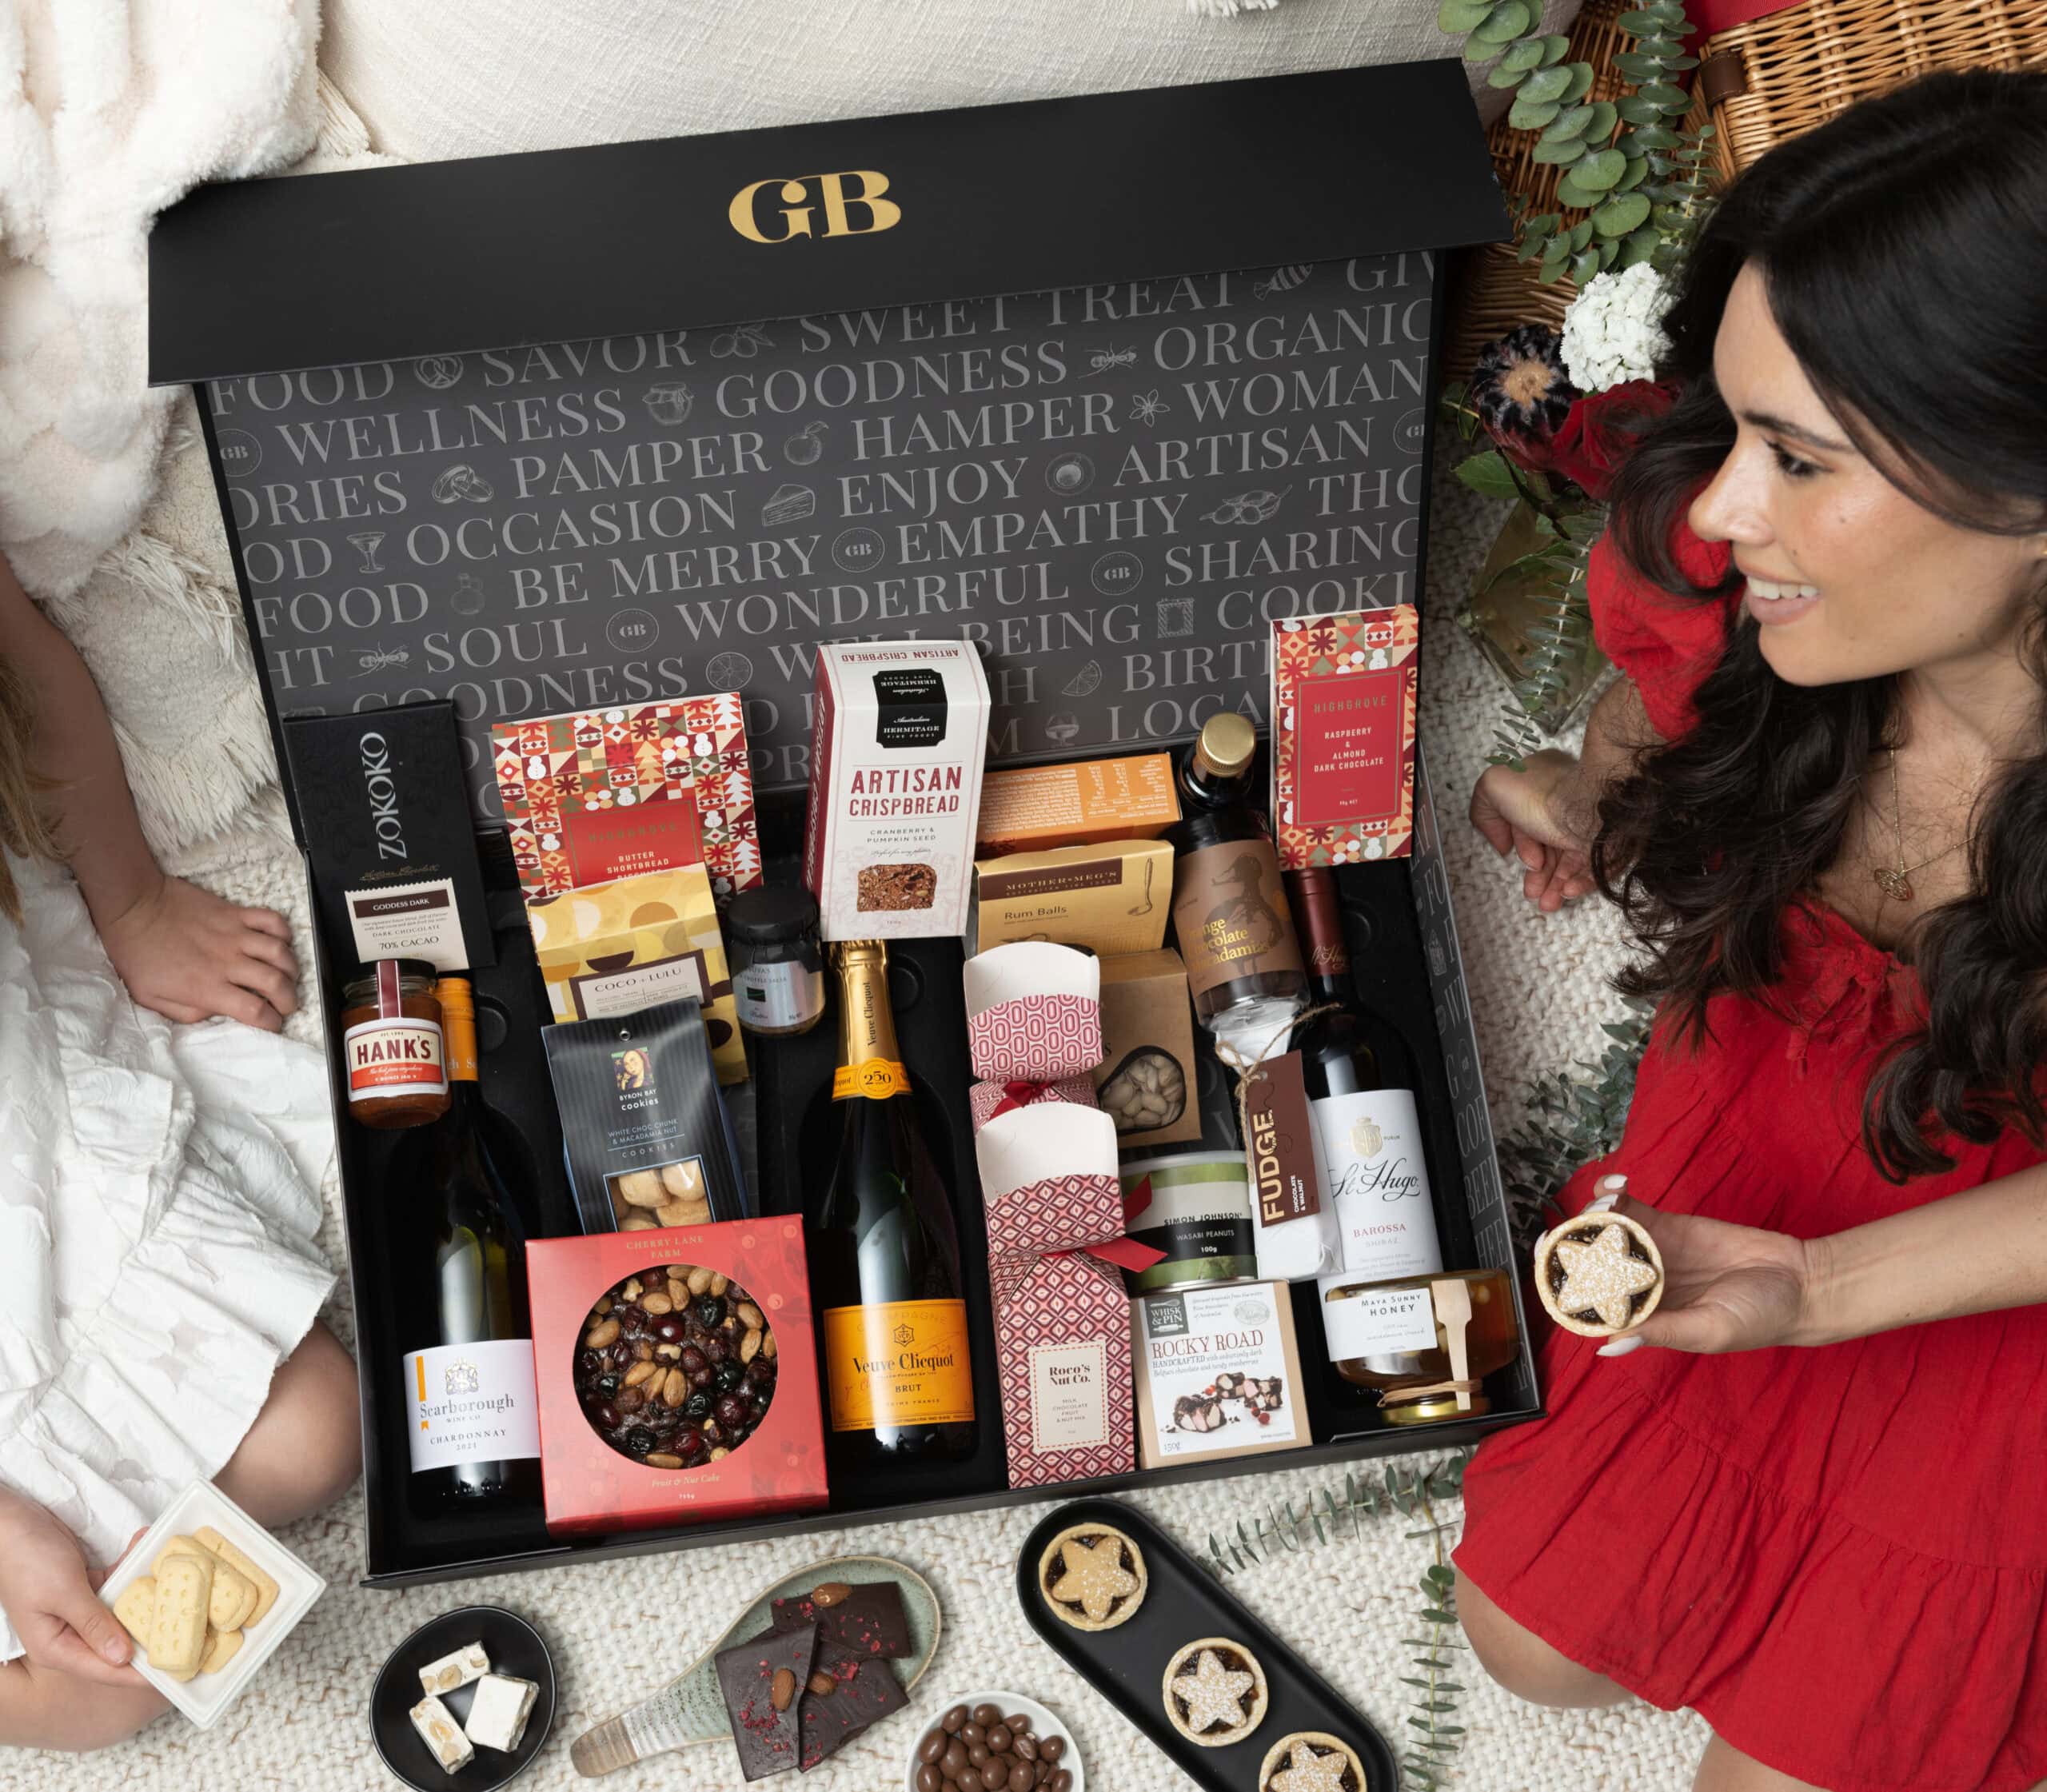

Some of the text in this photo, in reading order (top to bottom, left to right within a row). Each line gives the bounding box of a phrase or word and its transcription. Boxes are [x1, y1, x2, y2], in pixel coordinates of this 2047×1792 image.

[728, 170, 902, 243] GB
[211, 362, 394, 416] FOOD
[481, 330, 696, 387] SAVOR
[800, 294, 1019, 353] SWEET
[1037, 272, 1243, 326] TREAT
[275, 298, 1432, 466] WELLNESS GOODNESS ORGANIC
[509, 432, 772, 499] PAMPER
[851, 393, 1119, 461] HAMPER
[1181, 355, 1428, 422] WOMAN
[406, 490, 736, 565] OCCASION
[836, 457, 1028, 518] ENJOY
[1113, 417, 1375, 486] ARTISAN
[509, 562, 589, 609] BE
[608, 535, 821, 597] MERRY
[844, 543, 872, 557] GB
[896, 493, 1190, 565] EMPATHY
[253, 583, 429, 638] FOOD
[424, 618, 588, 673] SOUL
[619, 623, 647, 638] GB
[674, 562, 1068, 641] WONDERFUL
[1103, 567, 1131, 581] GB
[958, 604, 1141, 658] BEING
[841, 649, 959, 662] ARTISAN CRISPBREAD
[1314, 695, 1387, 714] HIGHGROVE
[1324, 727, 1372, 740] RASPBERRY
[1332, 749, 1366, 760] ALMOND
[1314, 757, 1384, 772] DARK CHOCOLATE
[850, 766, 962, 794] ARTISAN
[360, 732, 407, 860] ZOKOKO
[849, 795, 960, 816] CRISPBREAD
[589, 822, 676, 844] HIGHGROVE
[618, 851, 655, 863] BUTTER
[607, 858, 669, 874] SHORTBREAD
[373, 897, 430, 911] GODDESS DARK
[1004, 909, 1033, 920] Rum
[1038, 905, 1067, 916] Balls
[395, 924, 441, 935] CHOCOLATE
[379, 936, 440, 951] 70% CACAO
[594, 973, 637, 992] COCO
[648, 968, 683, 982] LULU
[868, 1016, 877, 1048] Veuve
[357, 1035, 431, 1065] HANK'S
[864, 1071, 892, 1085] 250
[619, 1091, 642, 1101] BYRON
[621, 1097, 659, 1111] cookies
[608, 1119, 678, 1138] WHITE CHOC CHUNK
[620, 1131, 662, 1143] MACADAMIA
[664, 1126, 678, 1135] NUT
[622, 1142, 675, 1158] COOKIES
[1253, 1109, 1284, 1222] FUDGE
[1288, 1174, 1299, 1213] CHOCOLATE
[1163, 1212, 1240, 1226] SIMON JOHNSON
[1175, 1231, 1203, 1241] WASABI
[1353, 1223, 1407, 1238] BAROSSA
[626, 1235, 704, 1249] CHERRY LANE
[652, 1249, 681, 1259] FARM
[1151, 1307, 1182, 1318] WHISK
[1370, 1304, 1415, 1316] HONEY
[1151, 1329, 1263, 1359] ROCKY ROAD
[852, 1352, 953, 1374] Veuve Clicquot
[1049, 1363, 1091, 1376] Roco's
[1152, 1355, 1206, 1368] HANDCRAFTED
[1051, 1373, 1091, 1386] Nut Co.
[895, 1384, 922, 1393] BRUT
[420, 1393, 514, 1419] Scarborough
[430, 1429, 506, 1445] CHARDONNAY
[1163, 1441, 1181, 1452] 150g
[652, 1478, 671, 1487] Fruit
[684, 1475, 699, 1485] Nut
